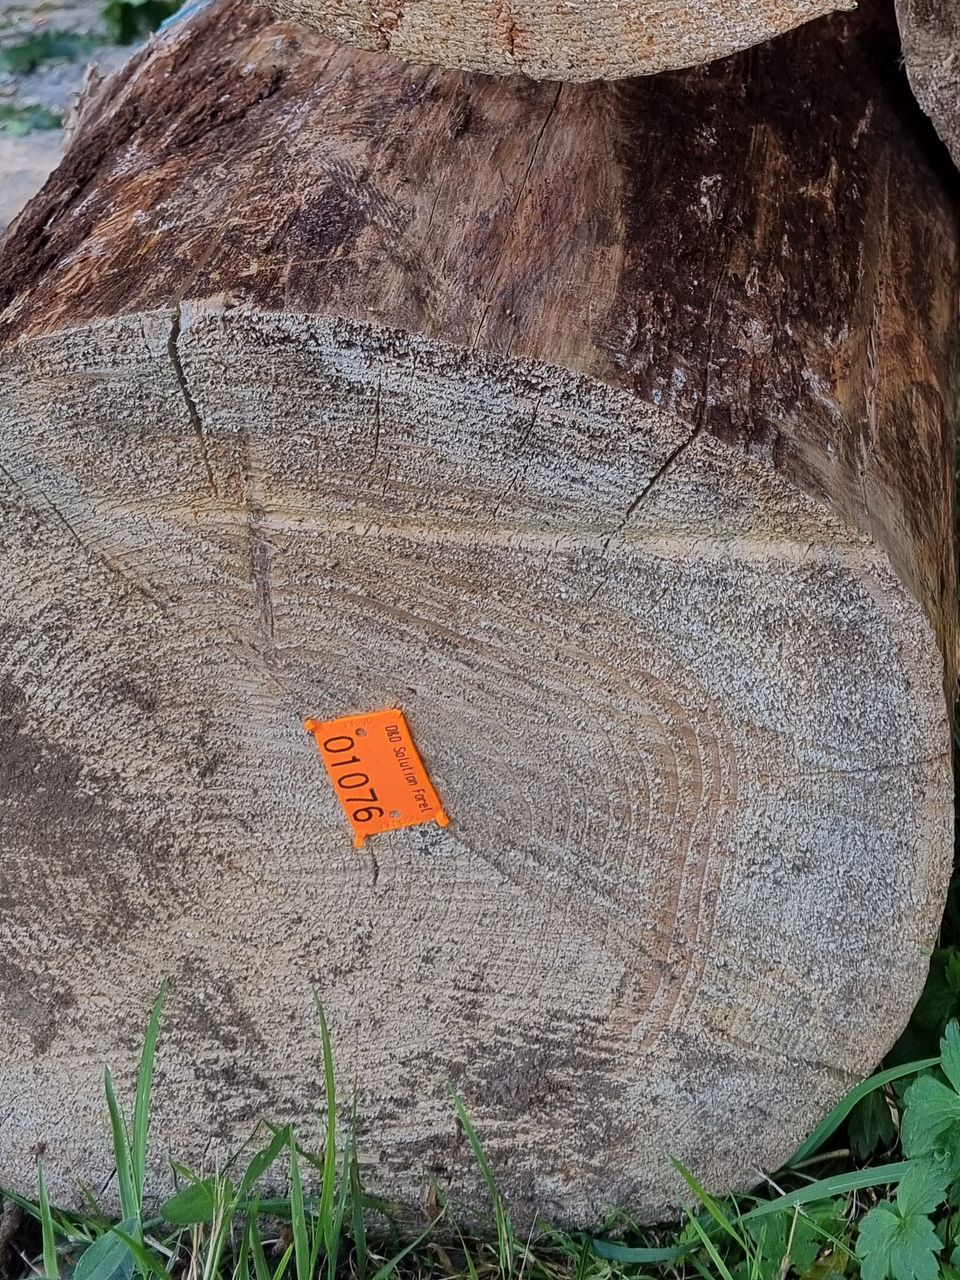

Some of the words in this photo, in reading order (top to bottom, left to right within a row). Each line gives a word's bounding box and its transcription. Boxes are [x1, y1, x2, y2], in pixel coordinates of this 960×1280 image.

[385, 725, 402, 743] D&D
[323, 735, 385, 823] 01076
[393, 746, 418, 786] Solution
[414, 788, 433, 813] Foret
